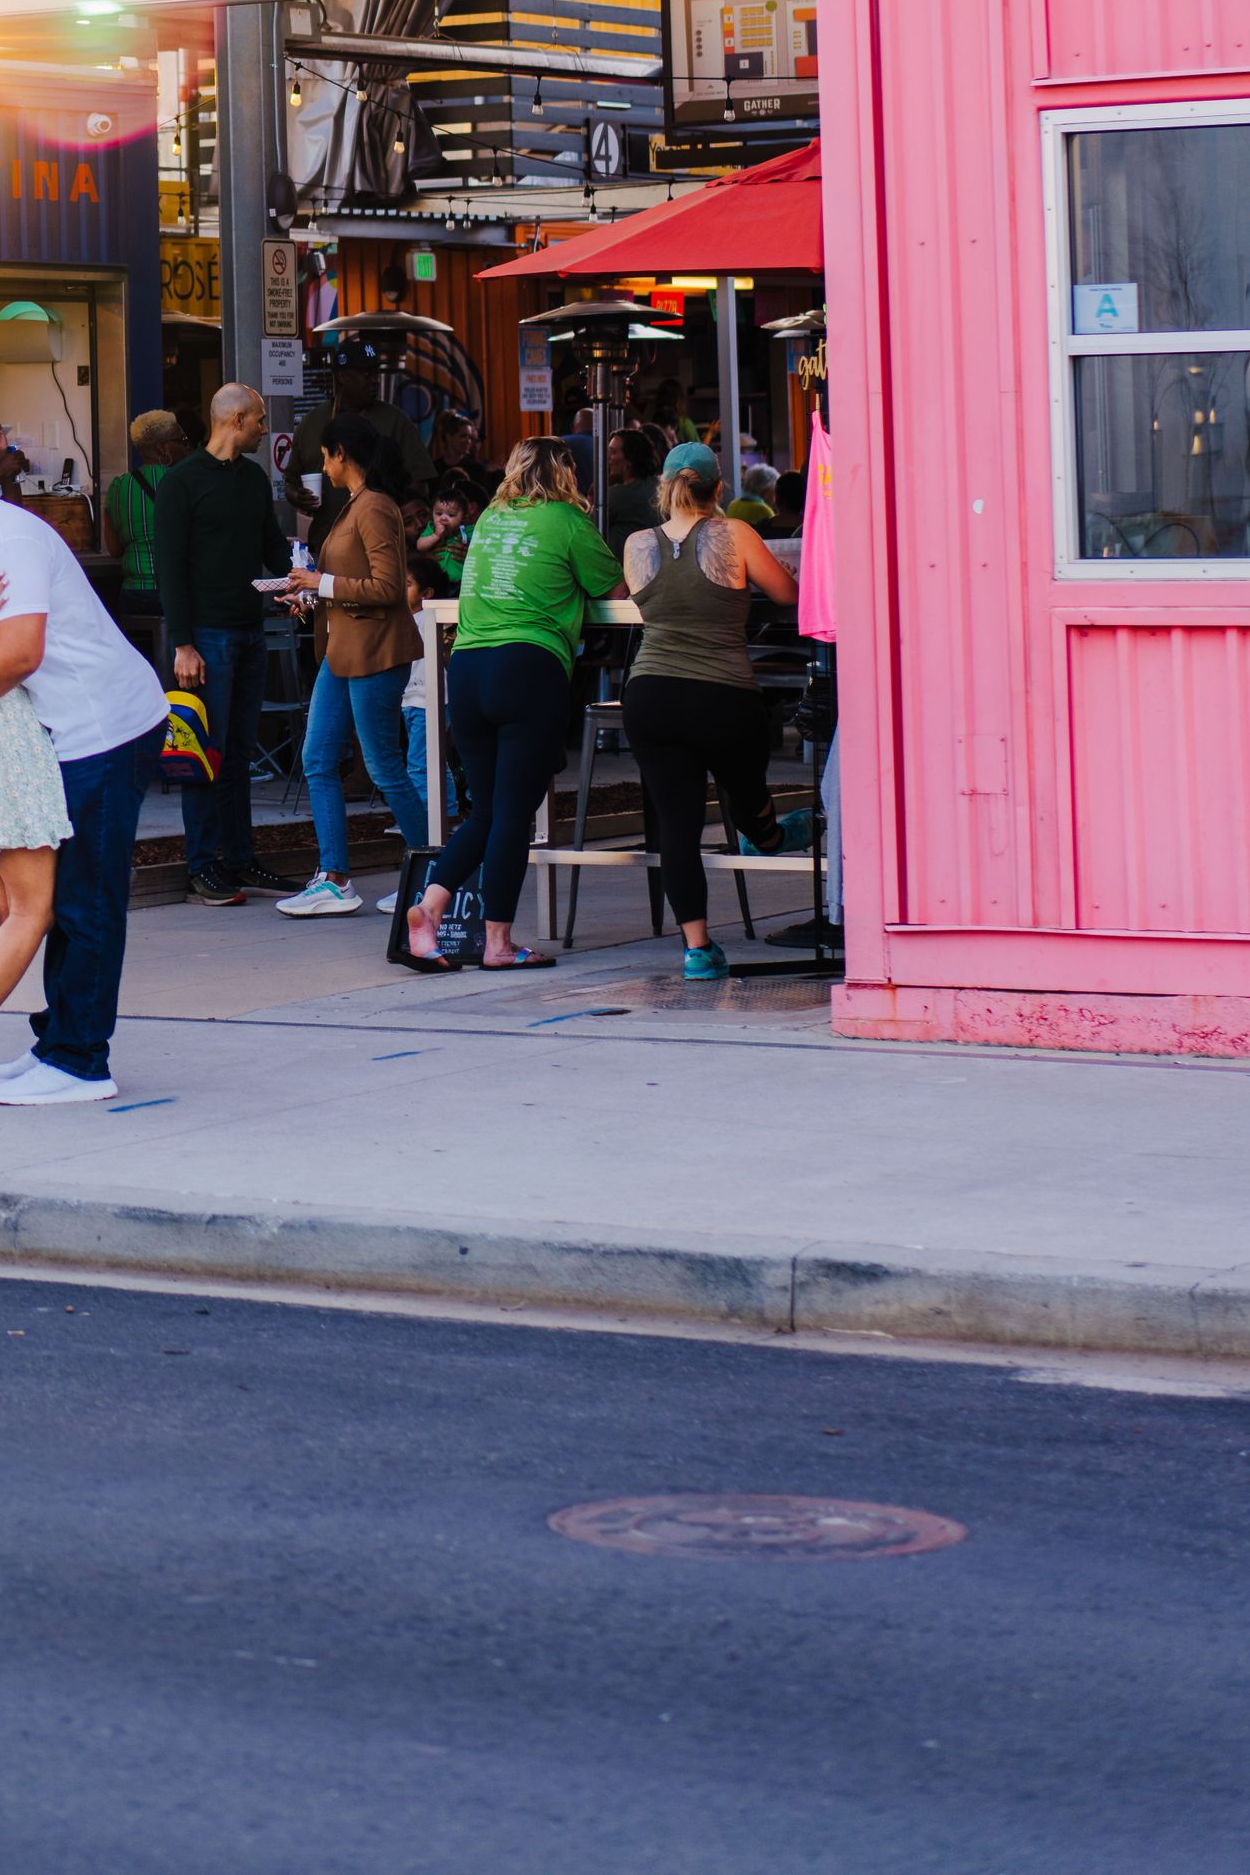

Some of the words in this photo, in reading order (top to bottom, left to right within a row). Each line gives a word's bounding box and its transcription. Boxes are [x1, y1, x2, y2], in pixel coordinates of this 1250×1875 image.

[744, 98, 781, 112] GATHER
[593, 122, 612, 176] 4
[270, 277, 279, 286] THIS
[267, 288, 293, 297] SMOKE-FREE
[269, 299, 291, 308] PROPERTY
[1096, 293, 1119, 317] A
[798, 338, 828, 390] gat
